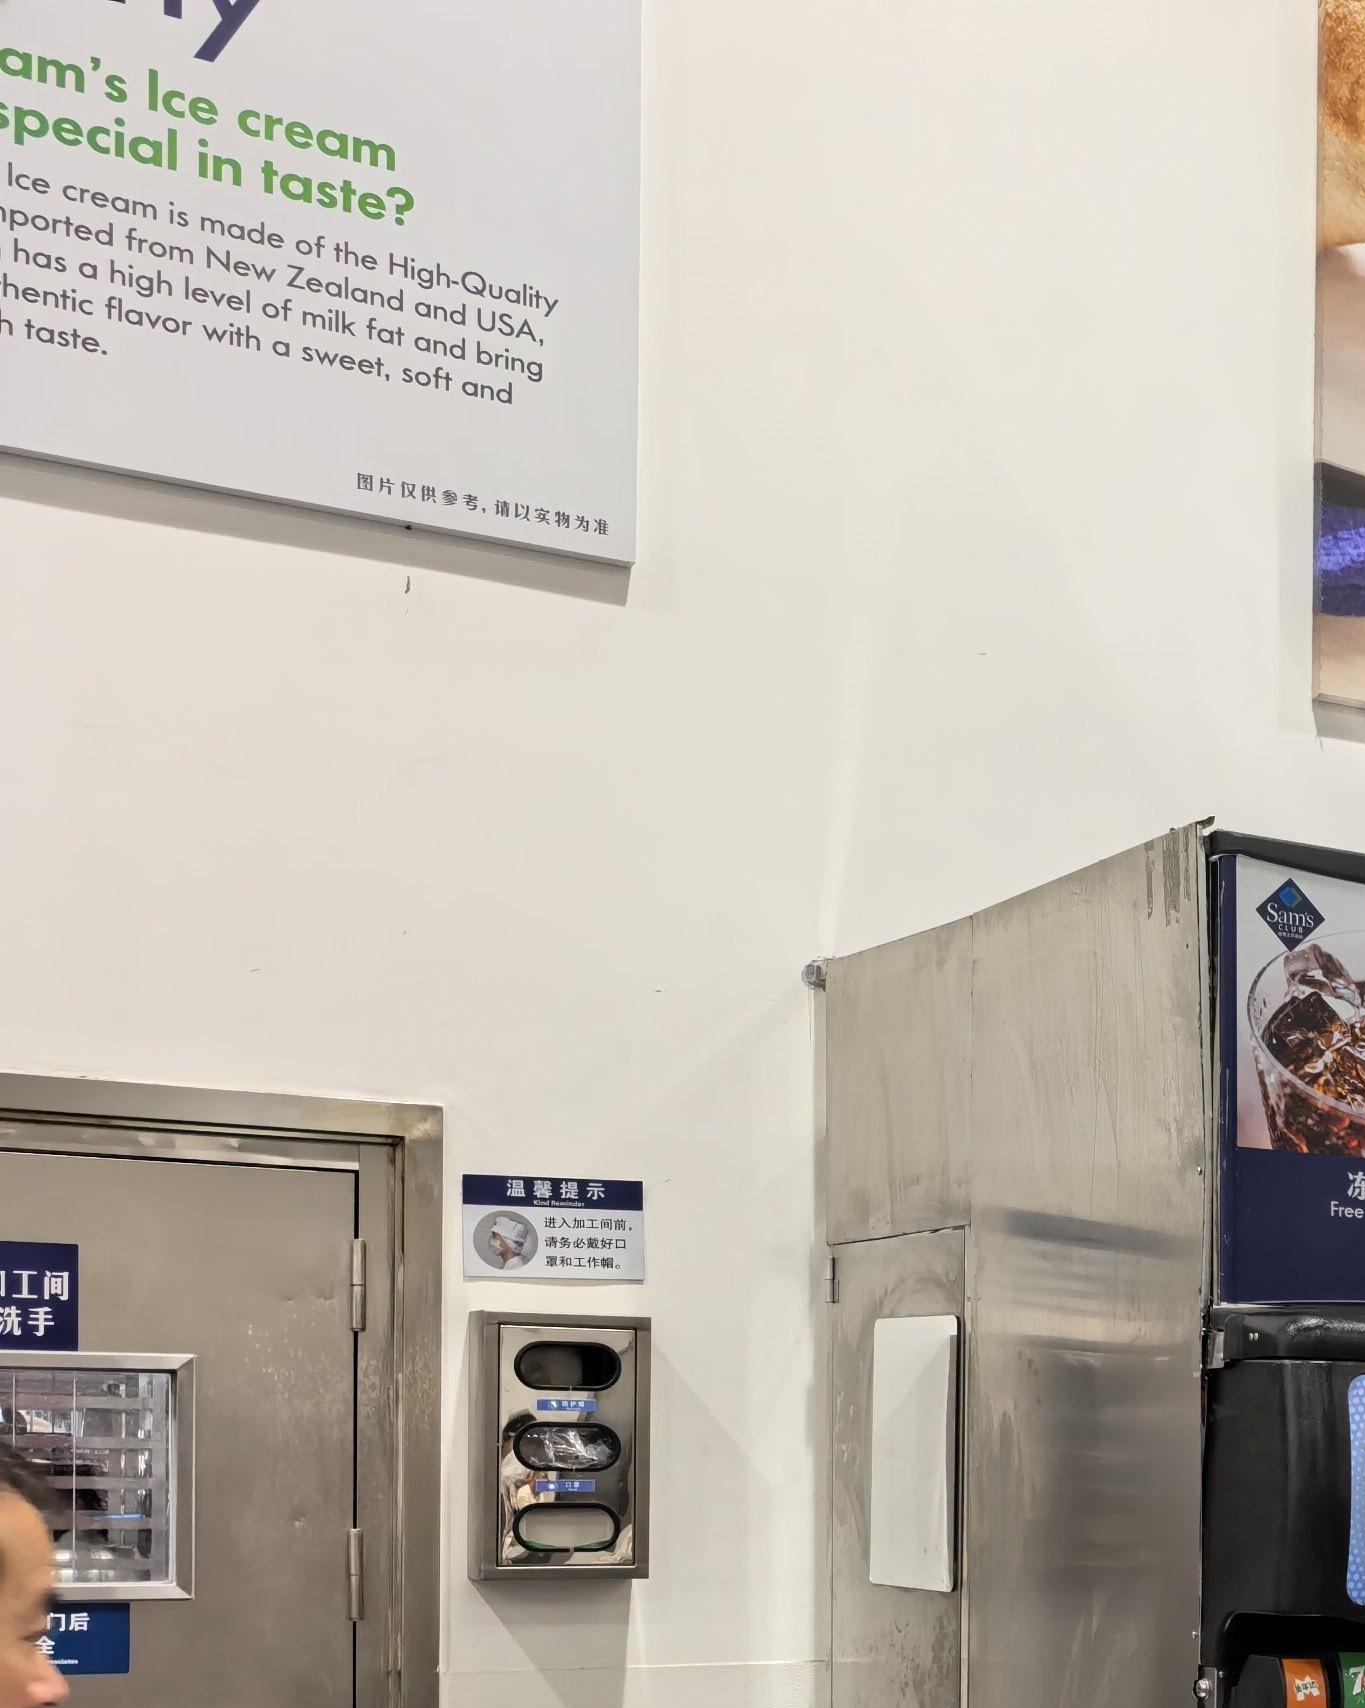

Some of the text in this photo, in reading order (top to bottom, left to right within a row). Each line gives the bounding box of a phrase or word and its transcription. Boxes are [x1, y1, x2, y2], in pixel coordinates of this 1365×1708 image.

[148, 68, 396, 171] Ice cream
[261, 164, 414, 226] taste?
[8, 162, 559, 317] Ice cream made High-Quality
[126, 229, 545, 347] from New Zealand USA,
[24, 317, 108, 356] taste.
[105, 299, 453, 393] flavor with sweet, soft
[109, 260, 543, 382] high level milk fat bring
[1267, 903, 1314, 927] Sam's
[1278, 924, 1303, 933] CLUB
[507, 1180, 605, 1200] 温馨提示
[1330, 1202, 1364, 1219] Free
[544, 1236, 626, 1249] 请务必戴好口
